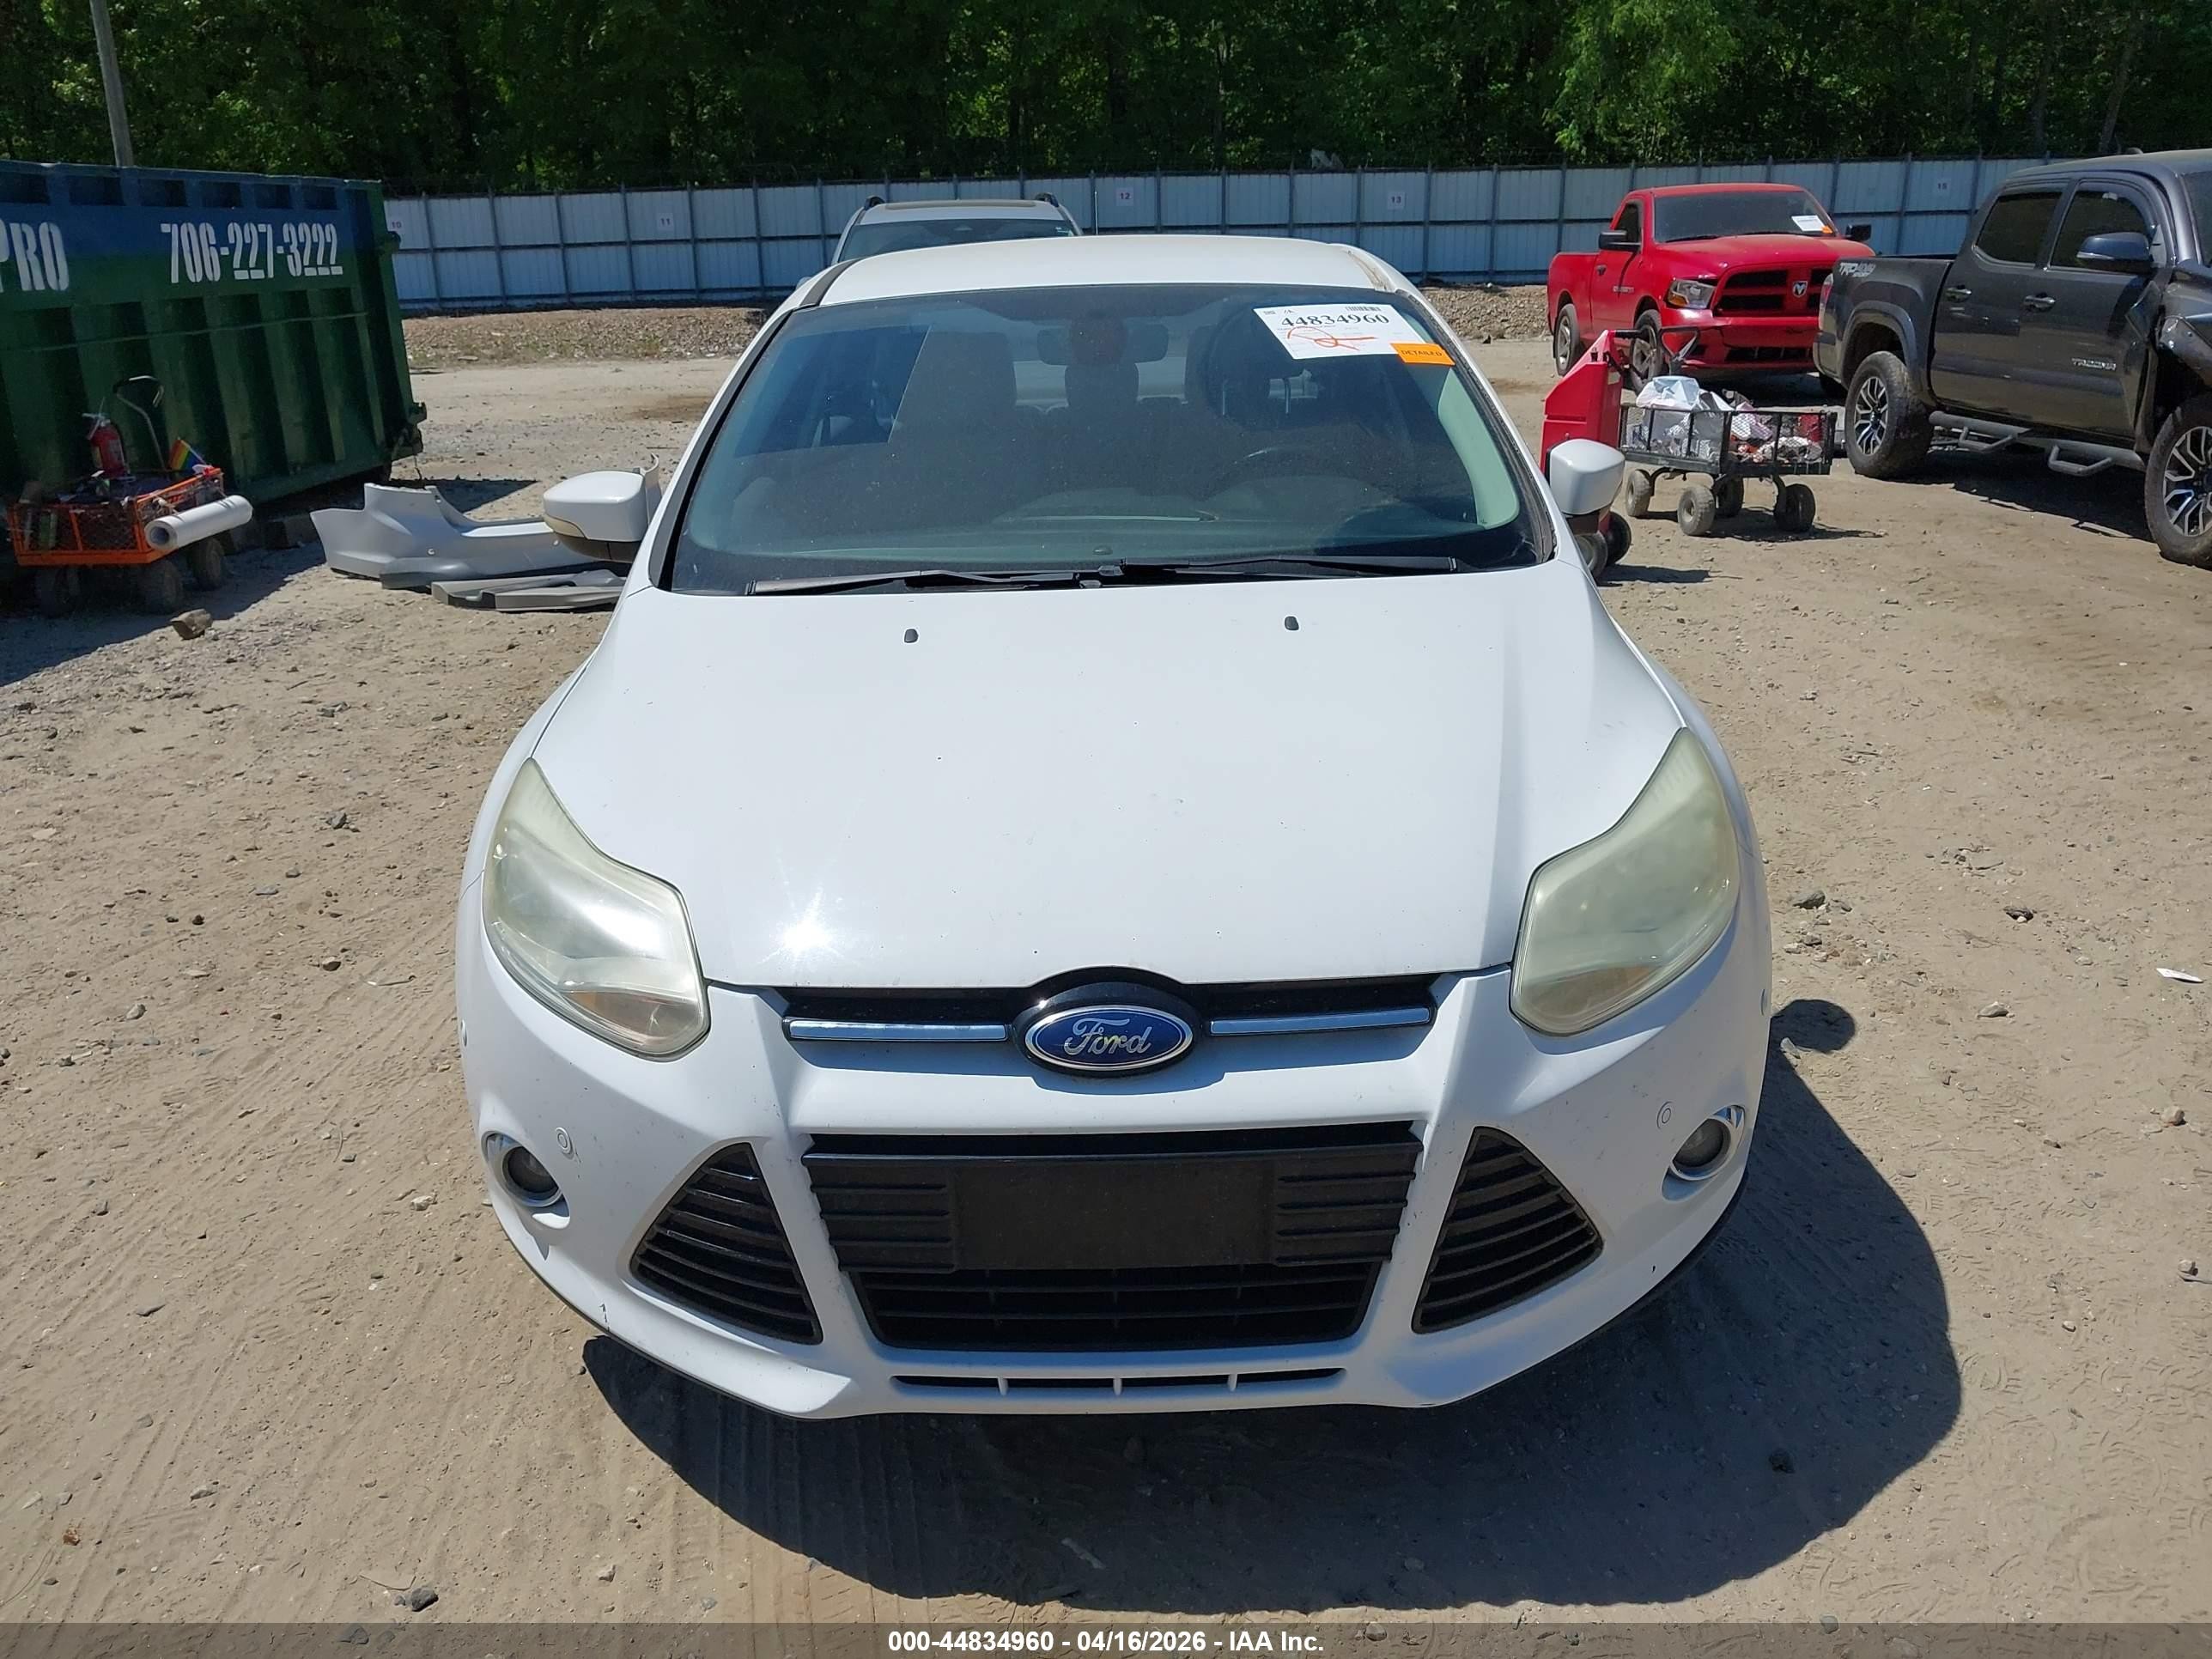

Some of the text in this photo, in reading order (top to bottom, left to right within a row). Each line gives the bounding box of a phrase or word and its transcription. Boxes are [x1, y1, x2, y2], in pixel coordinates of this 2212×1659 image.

[1120, 191, 1132, 200] 12
[660, 217, 671, 226] 11
[161, 222, 343, 283] 706-227-3222
[1281, 313, 1389, 327] 44834960
[1063, 1018, 1152, 1054] Ford
